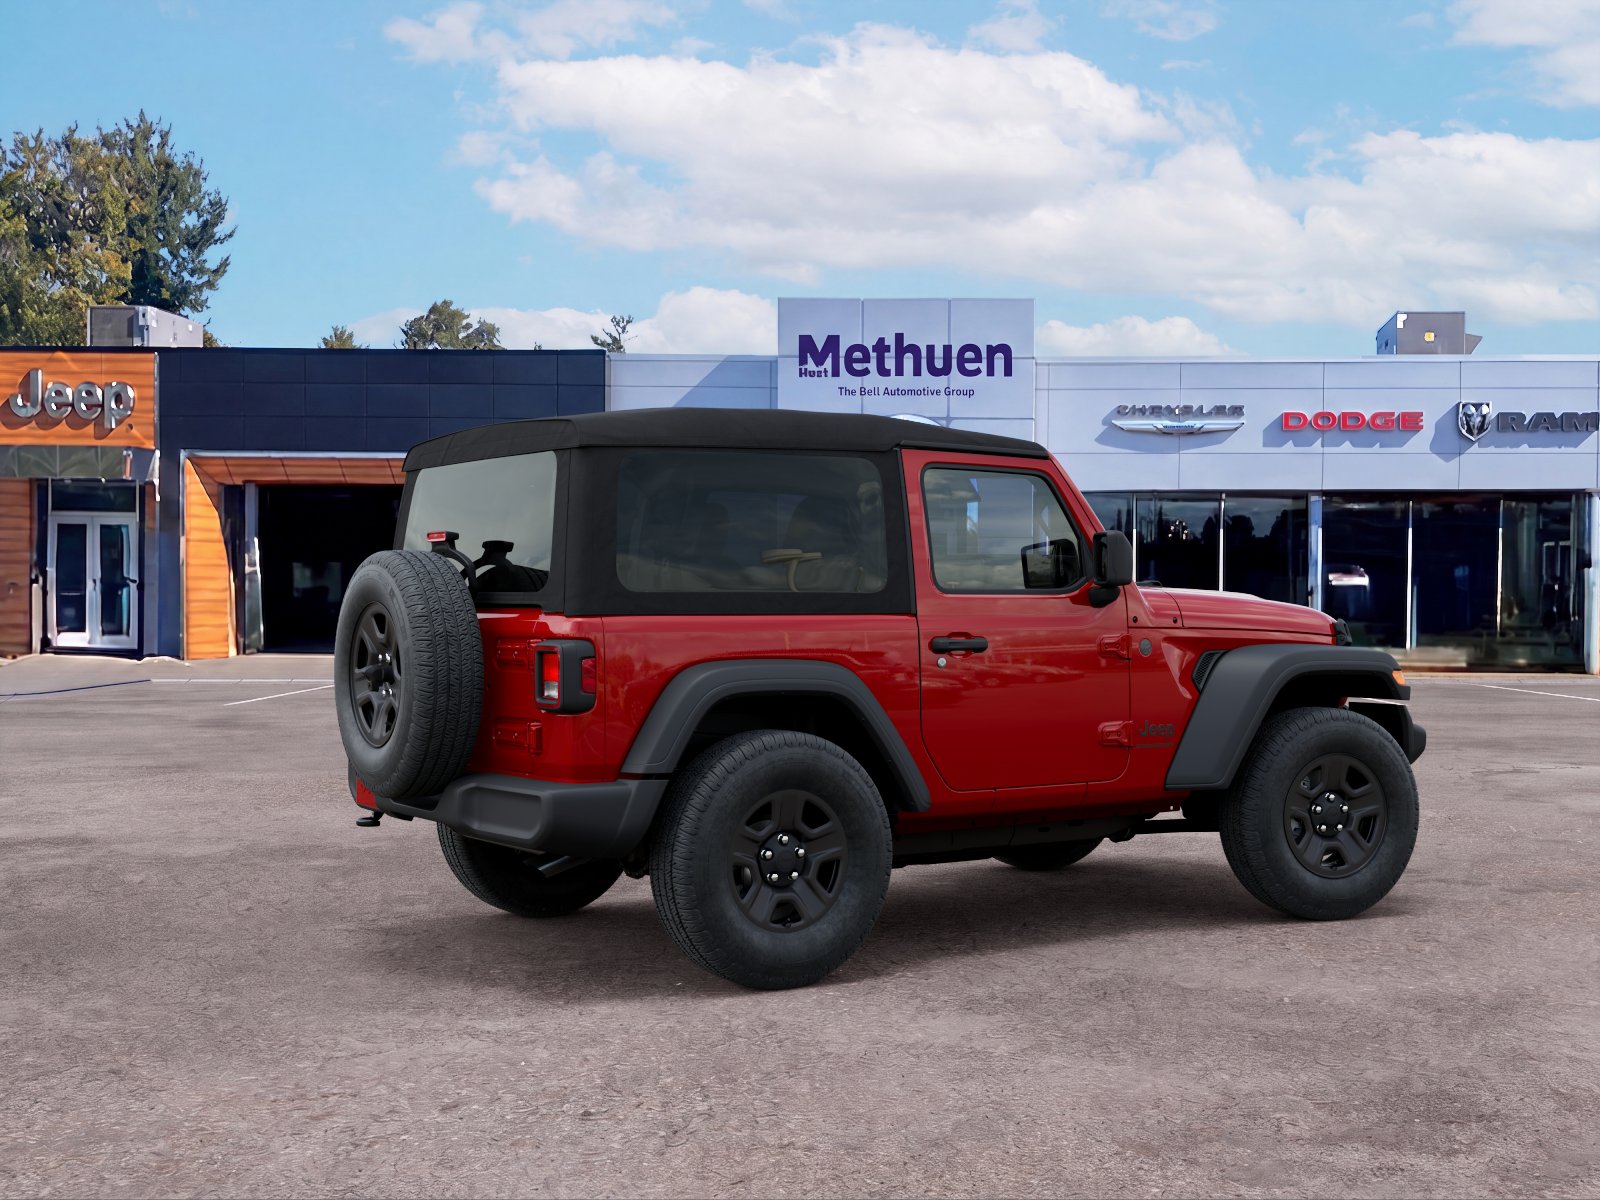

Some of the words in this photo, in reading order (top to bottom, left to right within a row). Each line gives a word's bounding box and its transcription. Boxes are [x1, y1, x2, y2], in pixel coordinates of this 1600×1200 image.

[798, 333, 1013, 378] Methuen
[9, 368, 136, 429] Jeep
[837, 386, 857, 396] The
[859, 386, 881, 396] Bell
[882, 386, 942, 397] Automotive
[943, 386, 976, 399] Group
[1282, 411, 1424, 431] DODGE
[1498, 411, 1599, 432] RAM
[1138, 719, 1176, 739] Jeep
